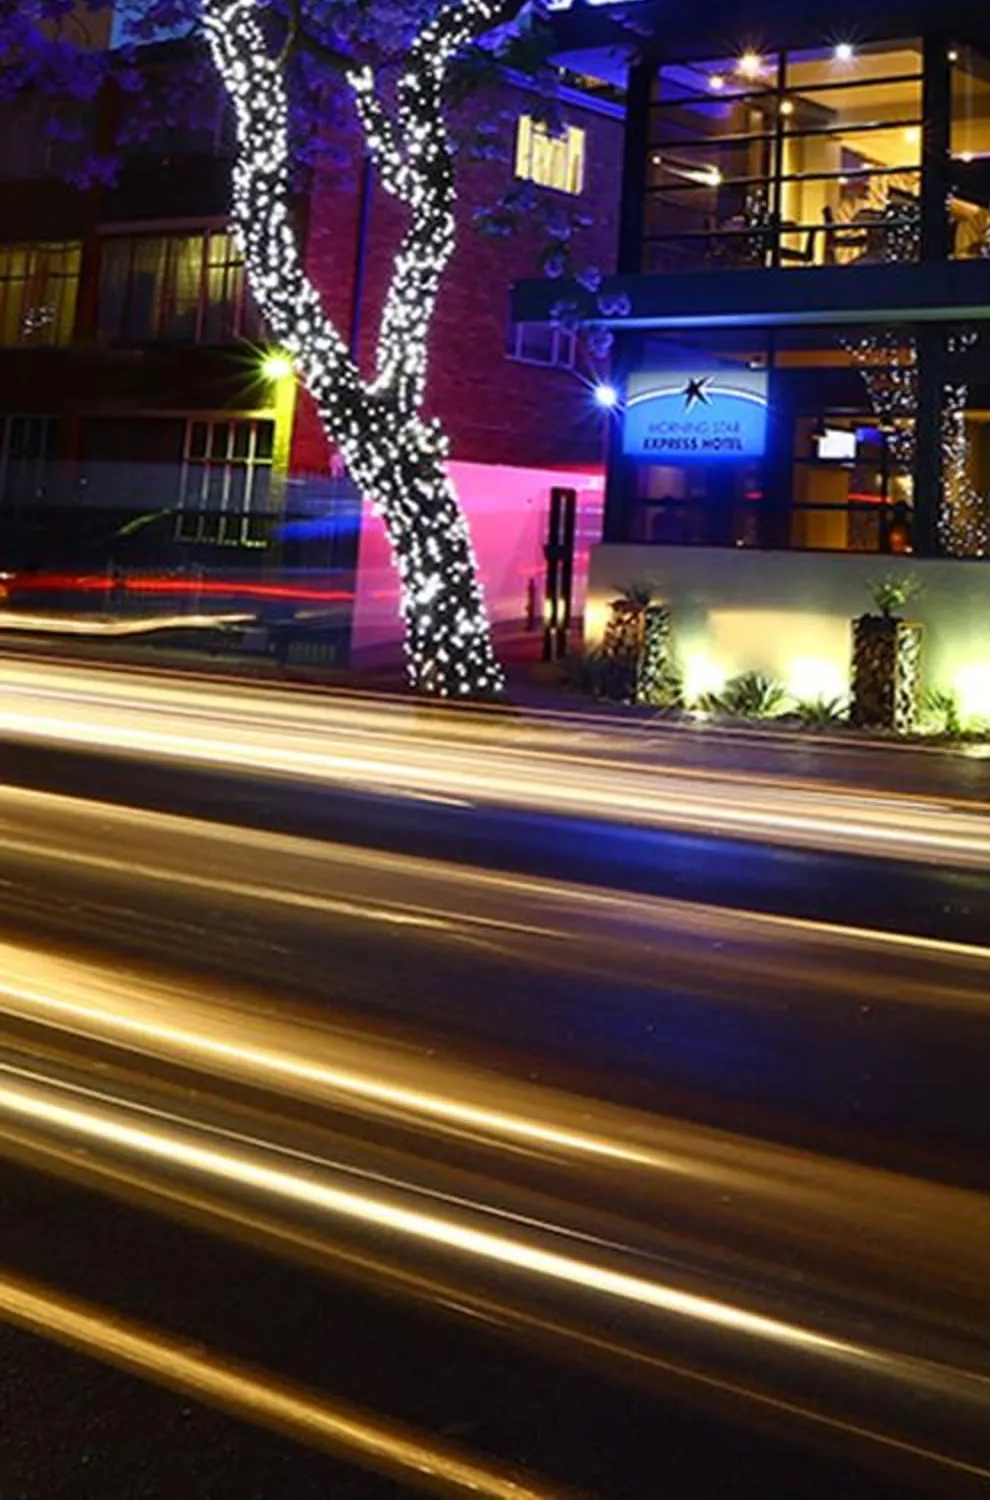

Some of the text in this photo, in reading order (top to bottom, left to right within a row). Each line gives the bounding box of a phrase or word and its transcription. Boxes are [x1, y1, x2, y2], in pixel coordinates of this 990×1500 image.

[648, 420, 740, 434] MORNING STAR
[643, 437, 743, 450] EXPRESS HOTEL
